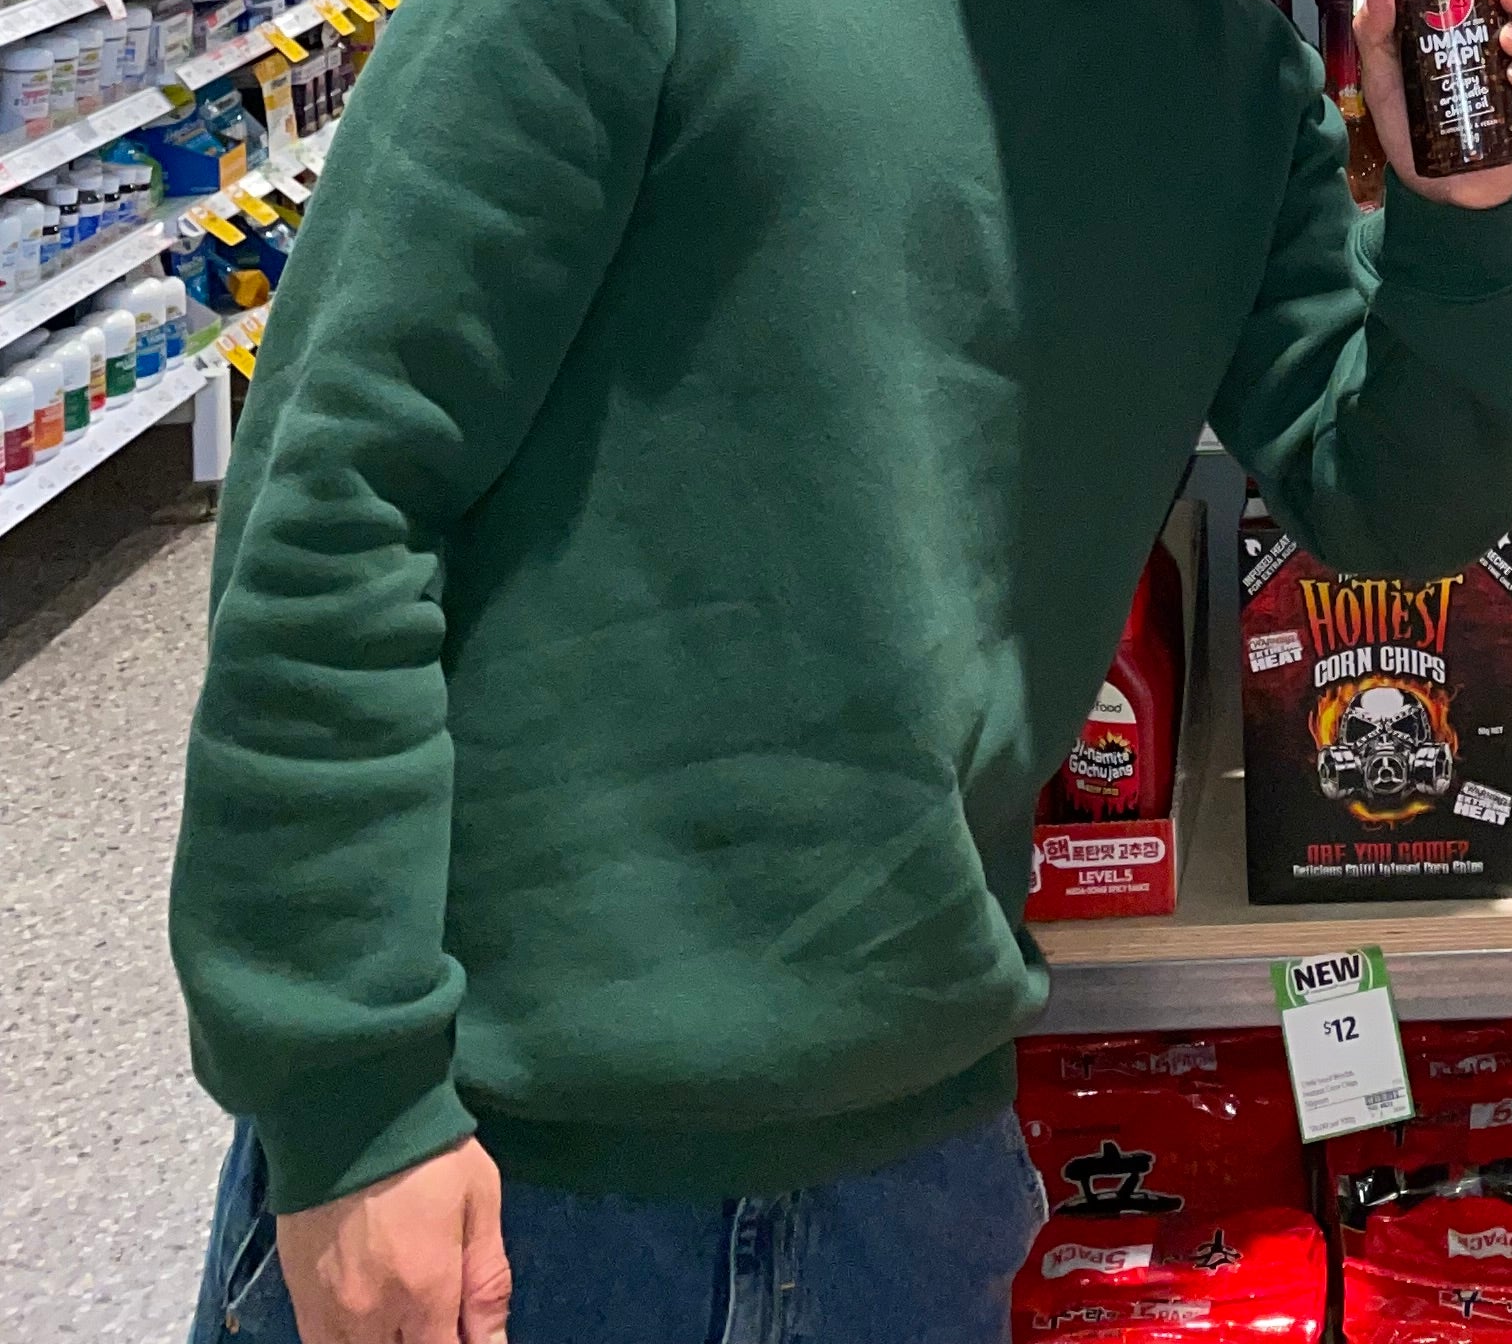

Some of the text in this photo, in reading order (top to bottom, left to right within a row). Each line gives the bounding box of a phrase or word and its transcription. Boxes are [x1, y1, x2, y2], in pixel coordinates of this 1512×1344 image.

[1419, 25, 1489, 54] UMAMI
[1434, 46, 1480, 70] PAPI
[1293, 955, 1360, 991] NEW
[1323, 1016, 1360, 1043] $12
